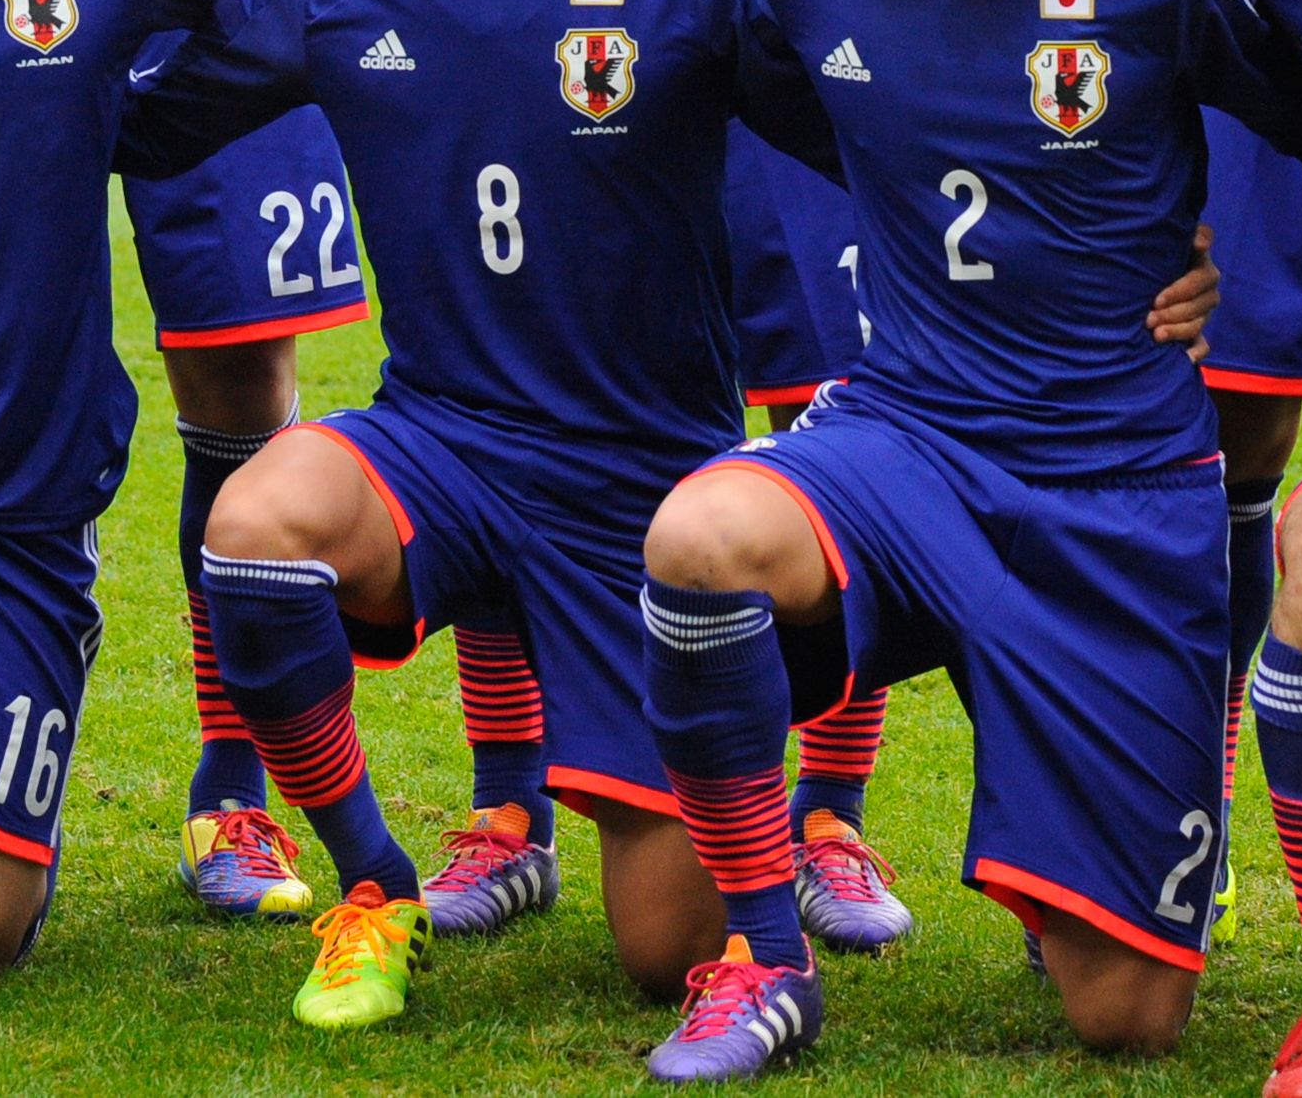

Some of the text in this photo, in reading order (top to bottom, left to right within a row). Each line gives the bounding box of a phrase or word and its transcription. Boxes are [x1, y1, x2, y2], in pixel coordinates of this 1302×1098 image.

[15, 55, 74, 68] JAPAN
[359, 53, 416, 71] adidas
[821, 60, 872, 83] adidas
[570, 126, 628, 136] JAPAN
[1040, 139, 1099, 150] JAPAN
[476, 163, 524, 275] 8
[940, 169, 994, 281] 2
[259, 182, 361, 296] 22
[1154, 809, 1213, 924] 2
